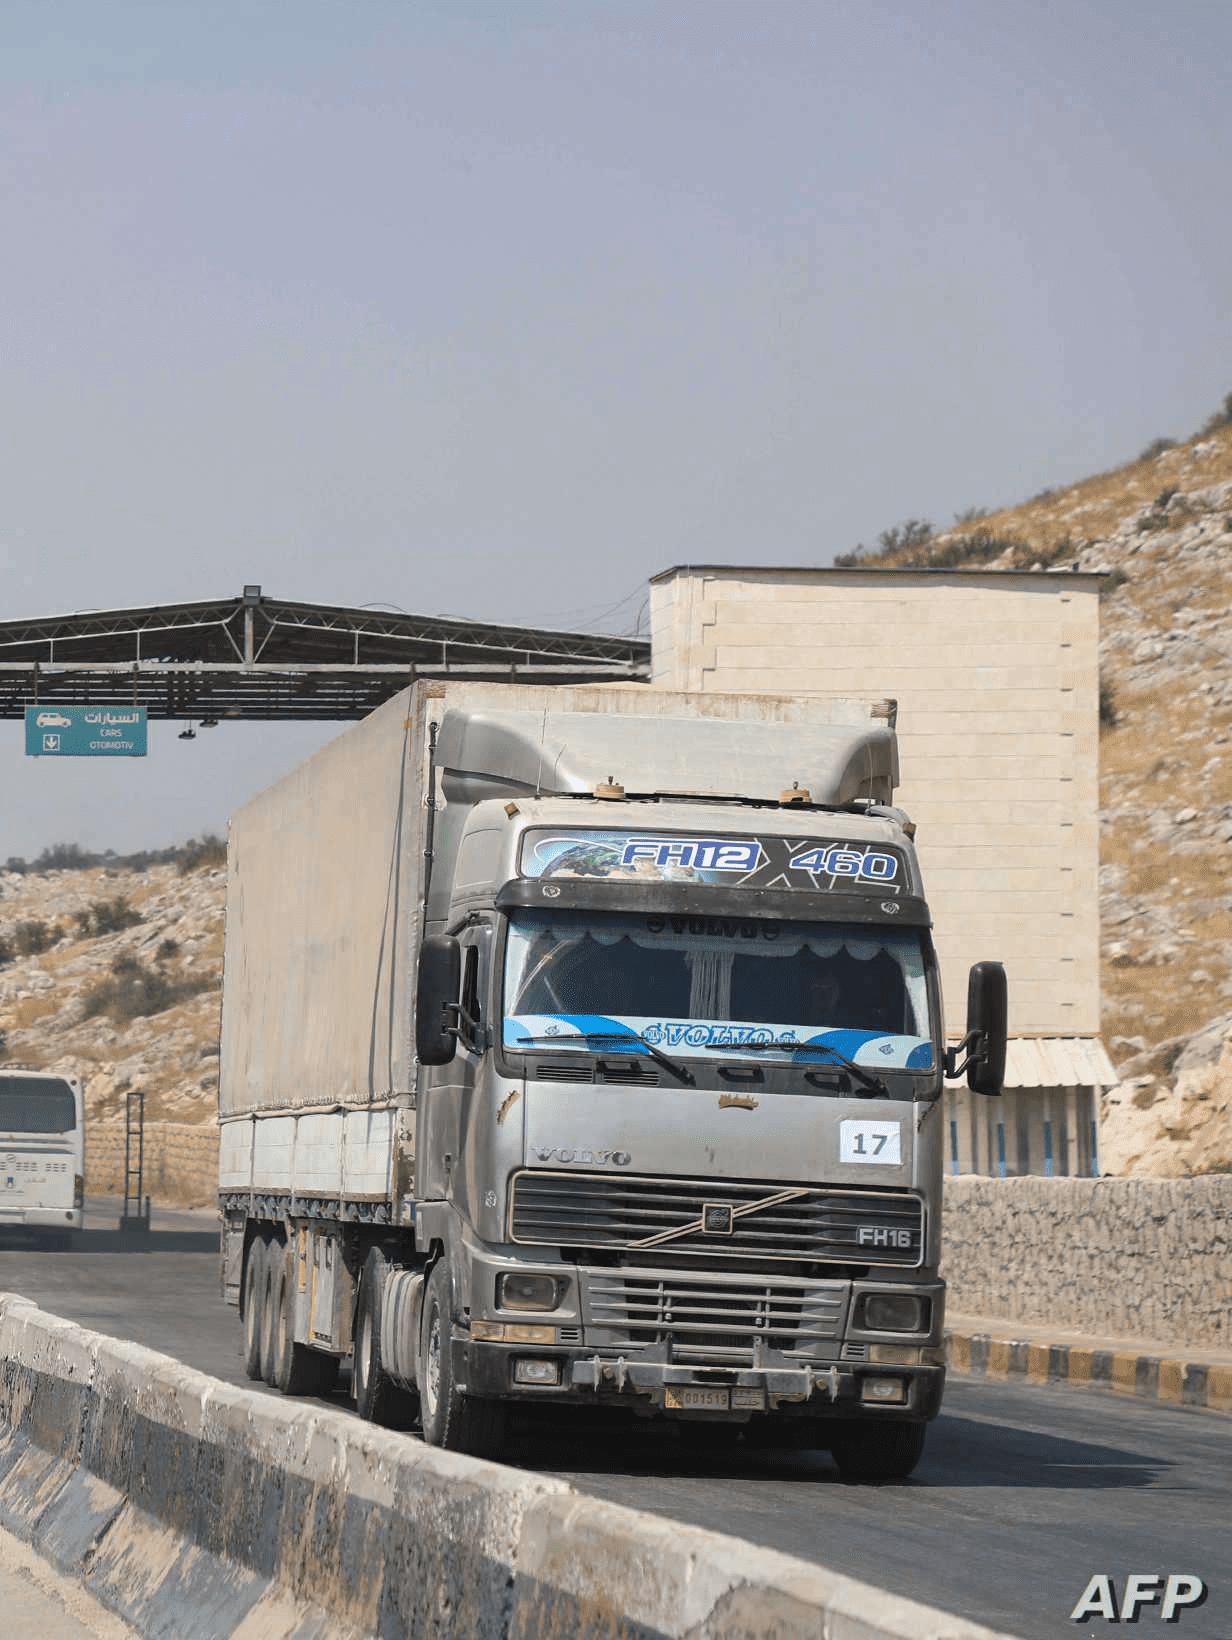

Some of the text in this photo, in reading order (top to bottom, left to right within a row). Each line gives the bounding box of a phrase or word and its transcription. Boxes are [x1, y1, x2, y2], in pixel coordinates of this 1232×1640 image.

[100, 728, 122, 737] CARS
[622, 841, 899, 880] FH12 460
[665, 1022, 774, 1049] VOLVO
[852, 1133, 888, 1155] 17
[528, 1146, 632, 1166] VOLVO
[858, 1228, 911, 1248] FH16
